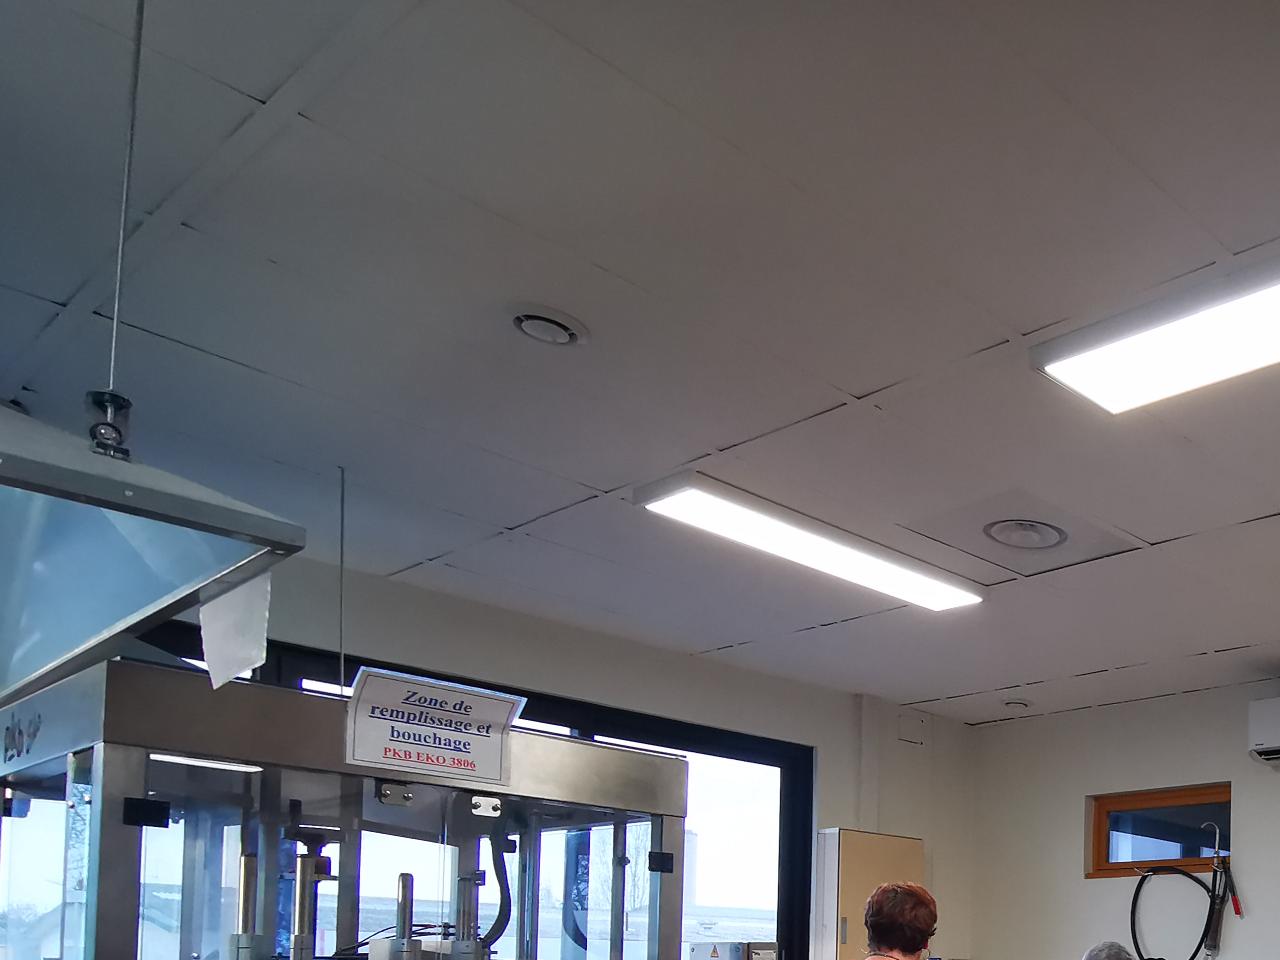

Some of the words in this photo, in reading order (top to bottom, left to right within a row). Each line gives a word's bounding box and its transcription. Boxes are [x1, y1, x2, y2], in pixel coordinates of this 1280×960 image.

[403, 690, 448, 709] Zone
[452, 699, 473, 713] de
[369, 704, 472, 733] remplissage
[476, 723, 492, 735] et
[390, 725, 472, 751] bouchage
[383, 746, 412, 760] PKB
[416, 749, 447, 765] EKO
